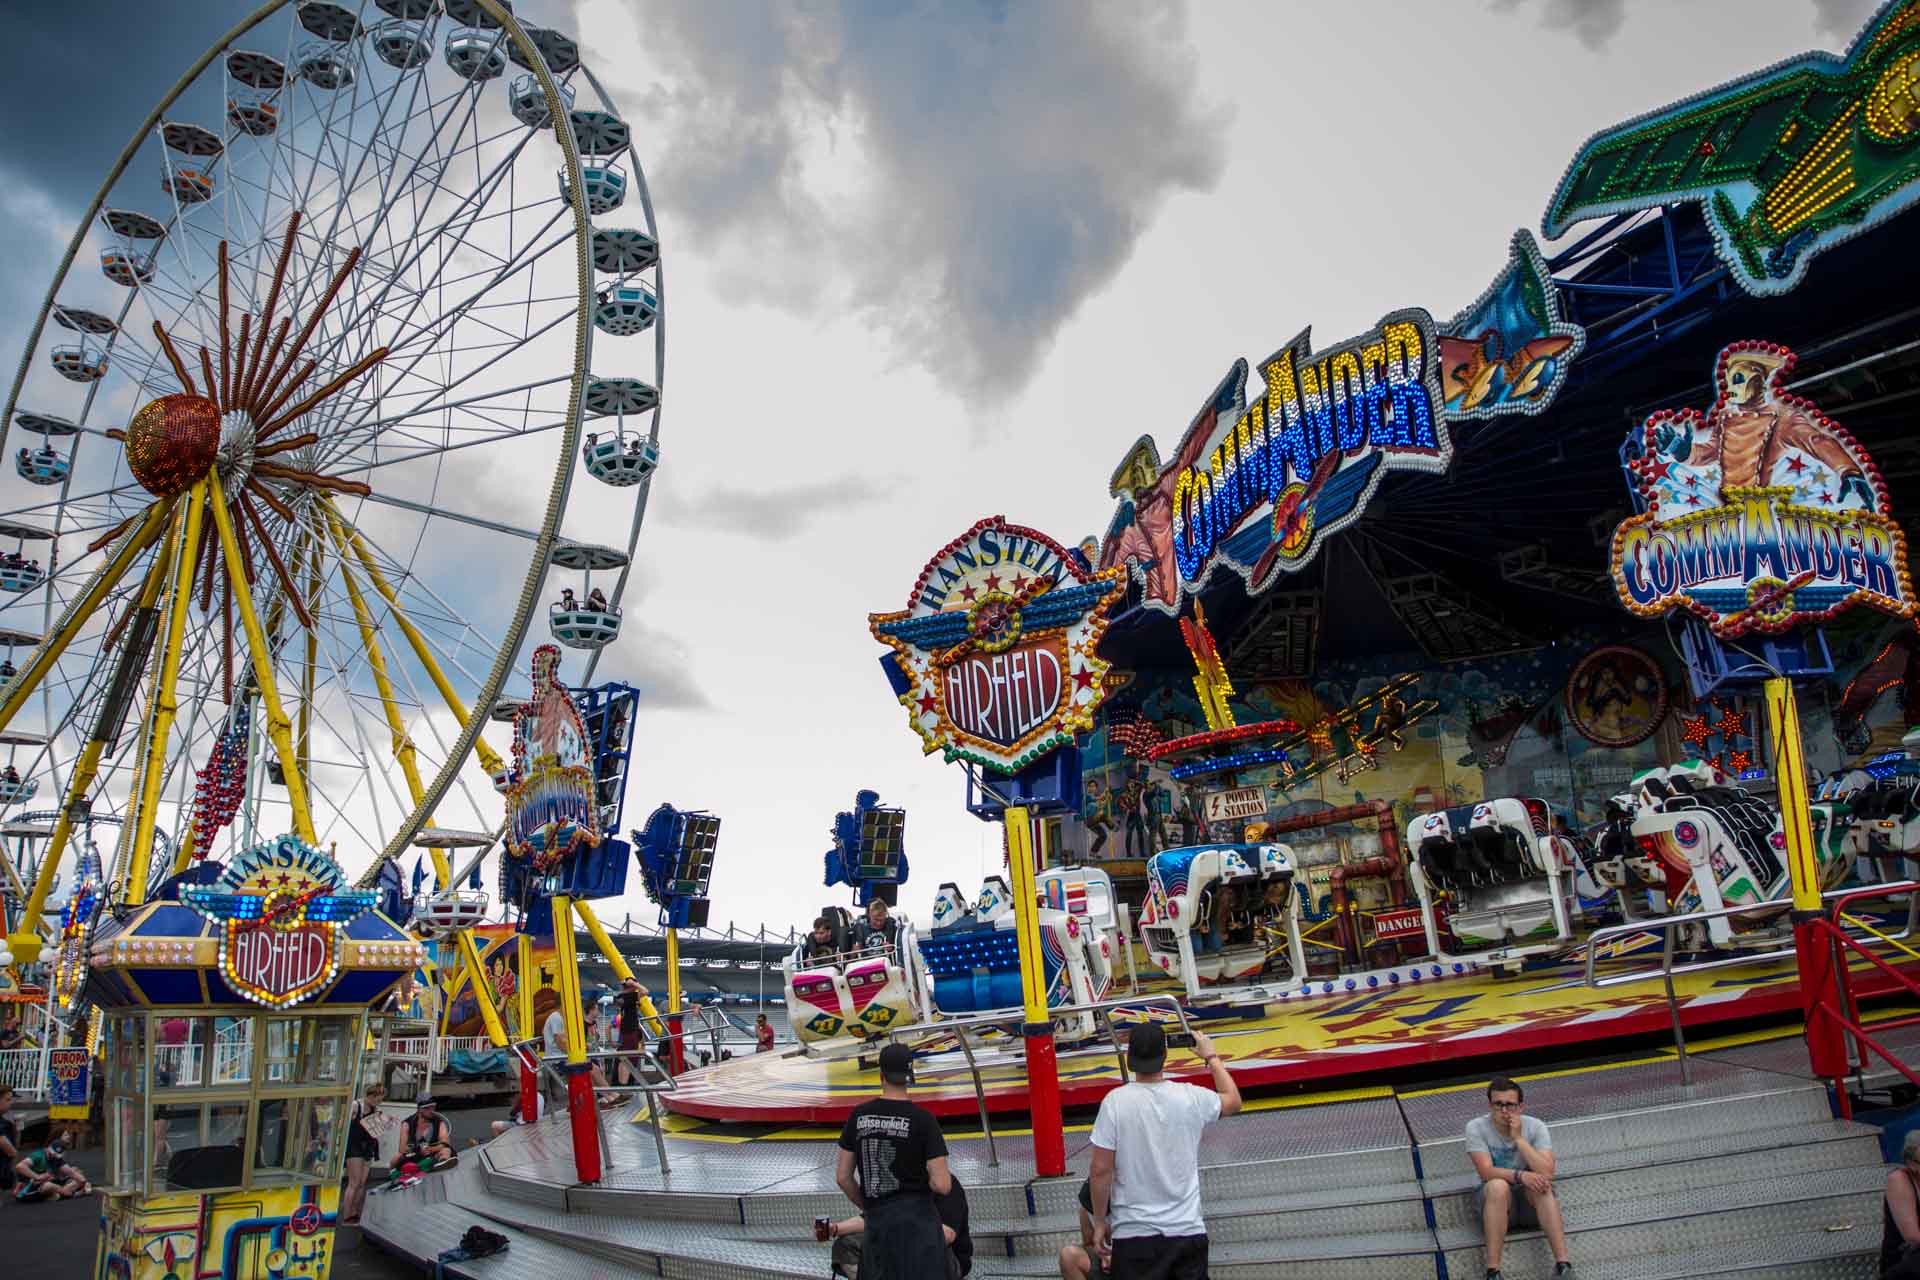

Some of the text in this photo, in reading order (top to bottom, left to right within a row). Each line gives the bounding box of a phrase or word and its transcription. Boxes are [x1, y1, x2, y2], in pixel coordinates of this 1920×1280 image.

[1172, 322, 1439, 581] COMMANDER
[920, 529, 1070, 610] HANSTEIN
[1621, 496, 1902, 605] COMMANDER
[946, 648, 1062, 741] AIRFIELD
[1224, 800, 1265, 817] STATION
[1225, 789, 1260, 804] POWER
[224, 841, 343, 890] HANSTEIN
[235, 931, 326, 993] AIRFIELD
[52, 1051, 87, 1066] EUROPA
